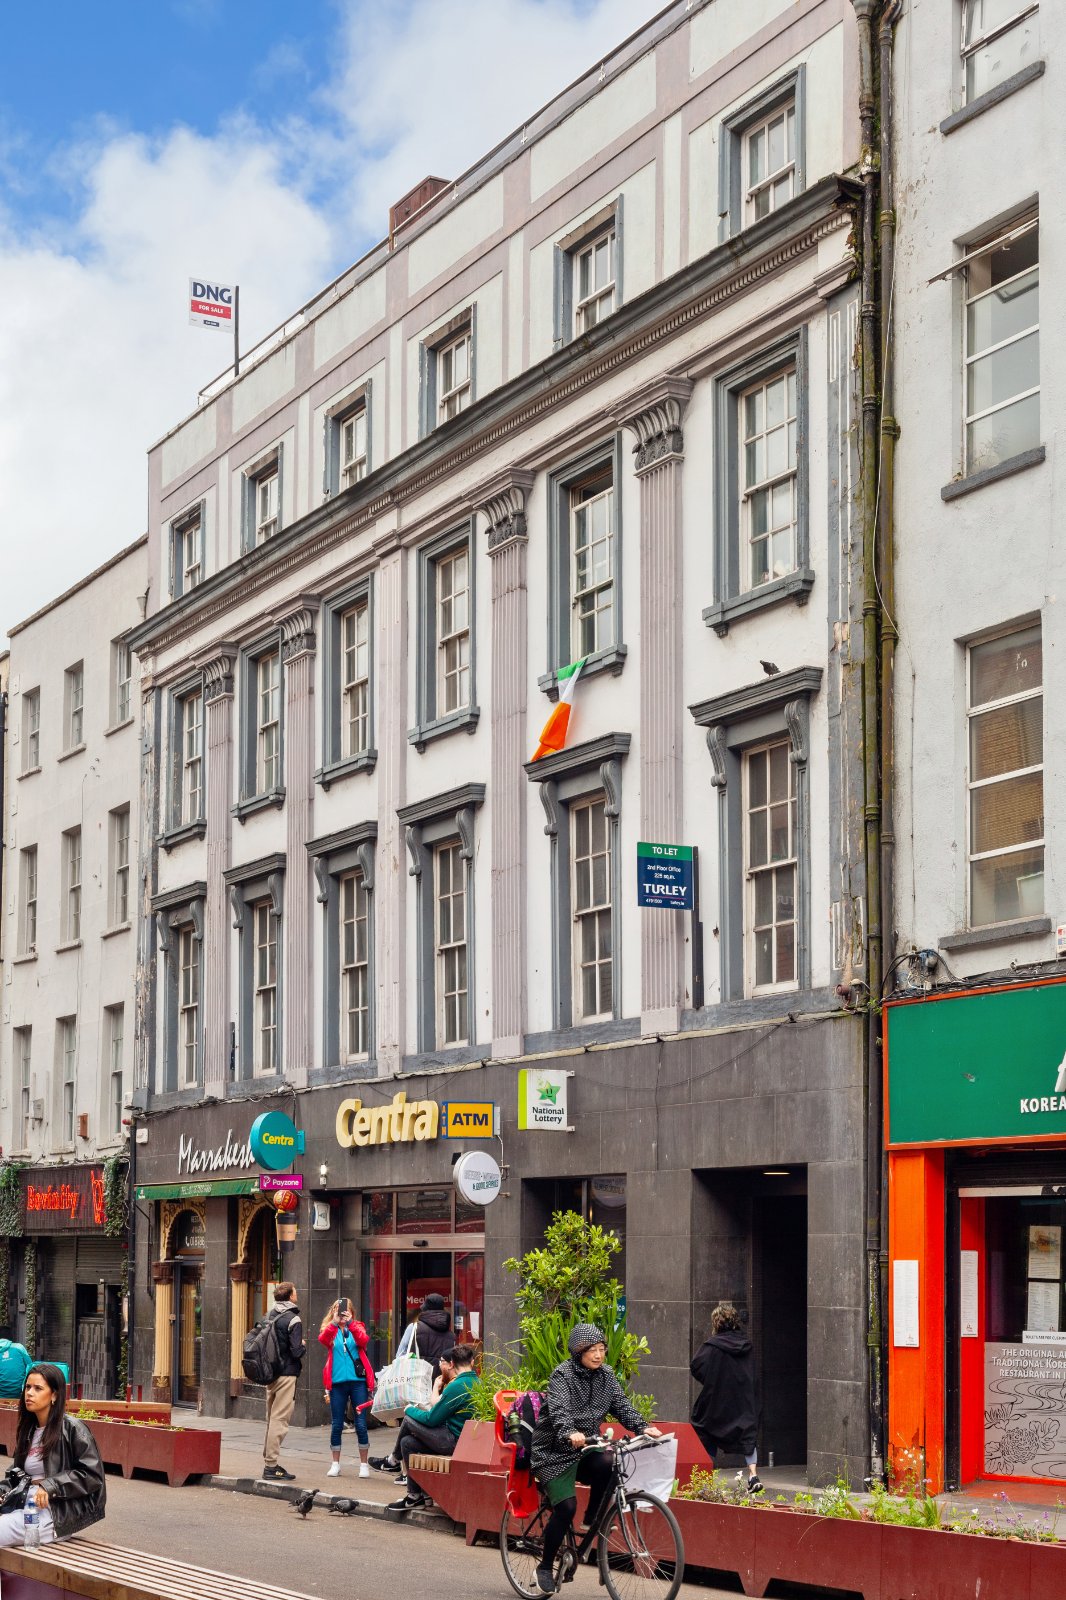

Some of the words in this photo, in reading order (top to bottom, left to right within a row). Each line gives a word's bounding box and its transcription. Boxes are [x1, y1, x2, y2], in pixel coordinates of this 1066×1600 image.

[192, 281, 232, 304] DNG
[210, 306, 224, 314] SALE
[652, 846, 662, 854] TO
[664, 847, 678, 856] LET
[643, 883, 687, 897] TURLEY
[532, 1106, 564, 1115] National
[335, 1091, 439, 1149] Centra
[451, 1112, 488, 1127] ATM
[534, 1114, 562, 1124] Lottery
[262, 1132, 294, 1146] Centra
[272, 1178, 299, 1187] Payzone
[1002, 1348, 1017, 1357] THE
[1019, 1349, 1057, 1358] ORIGINAL
[992, 1356, 1044, 1368] TRADITIONAL
[999, 1369, 1050, 1379] RESTAURANT
[1052, 1371, 1061, 1380] IN
